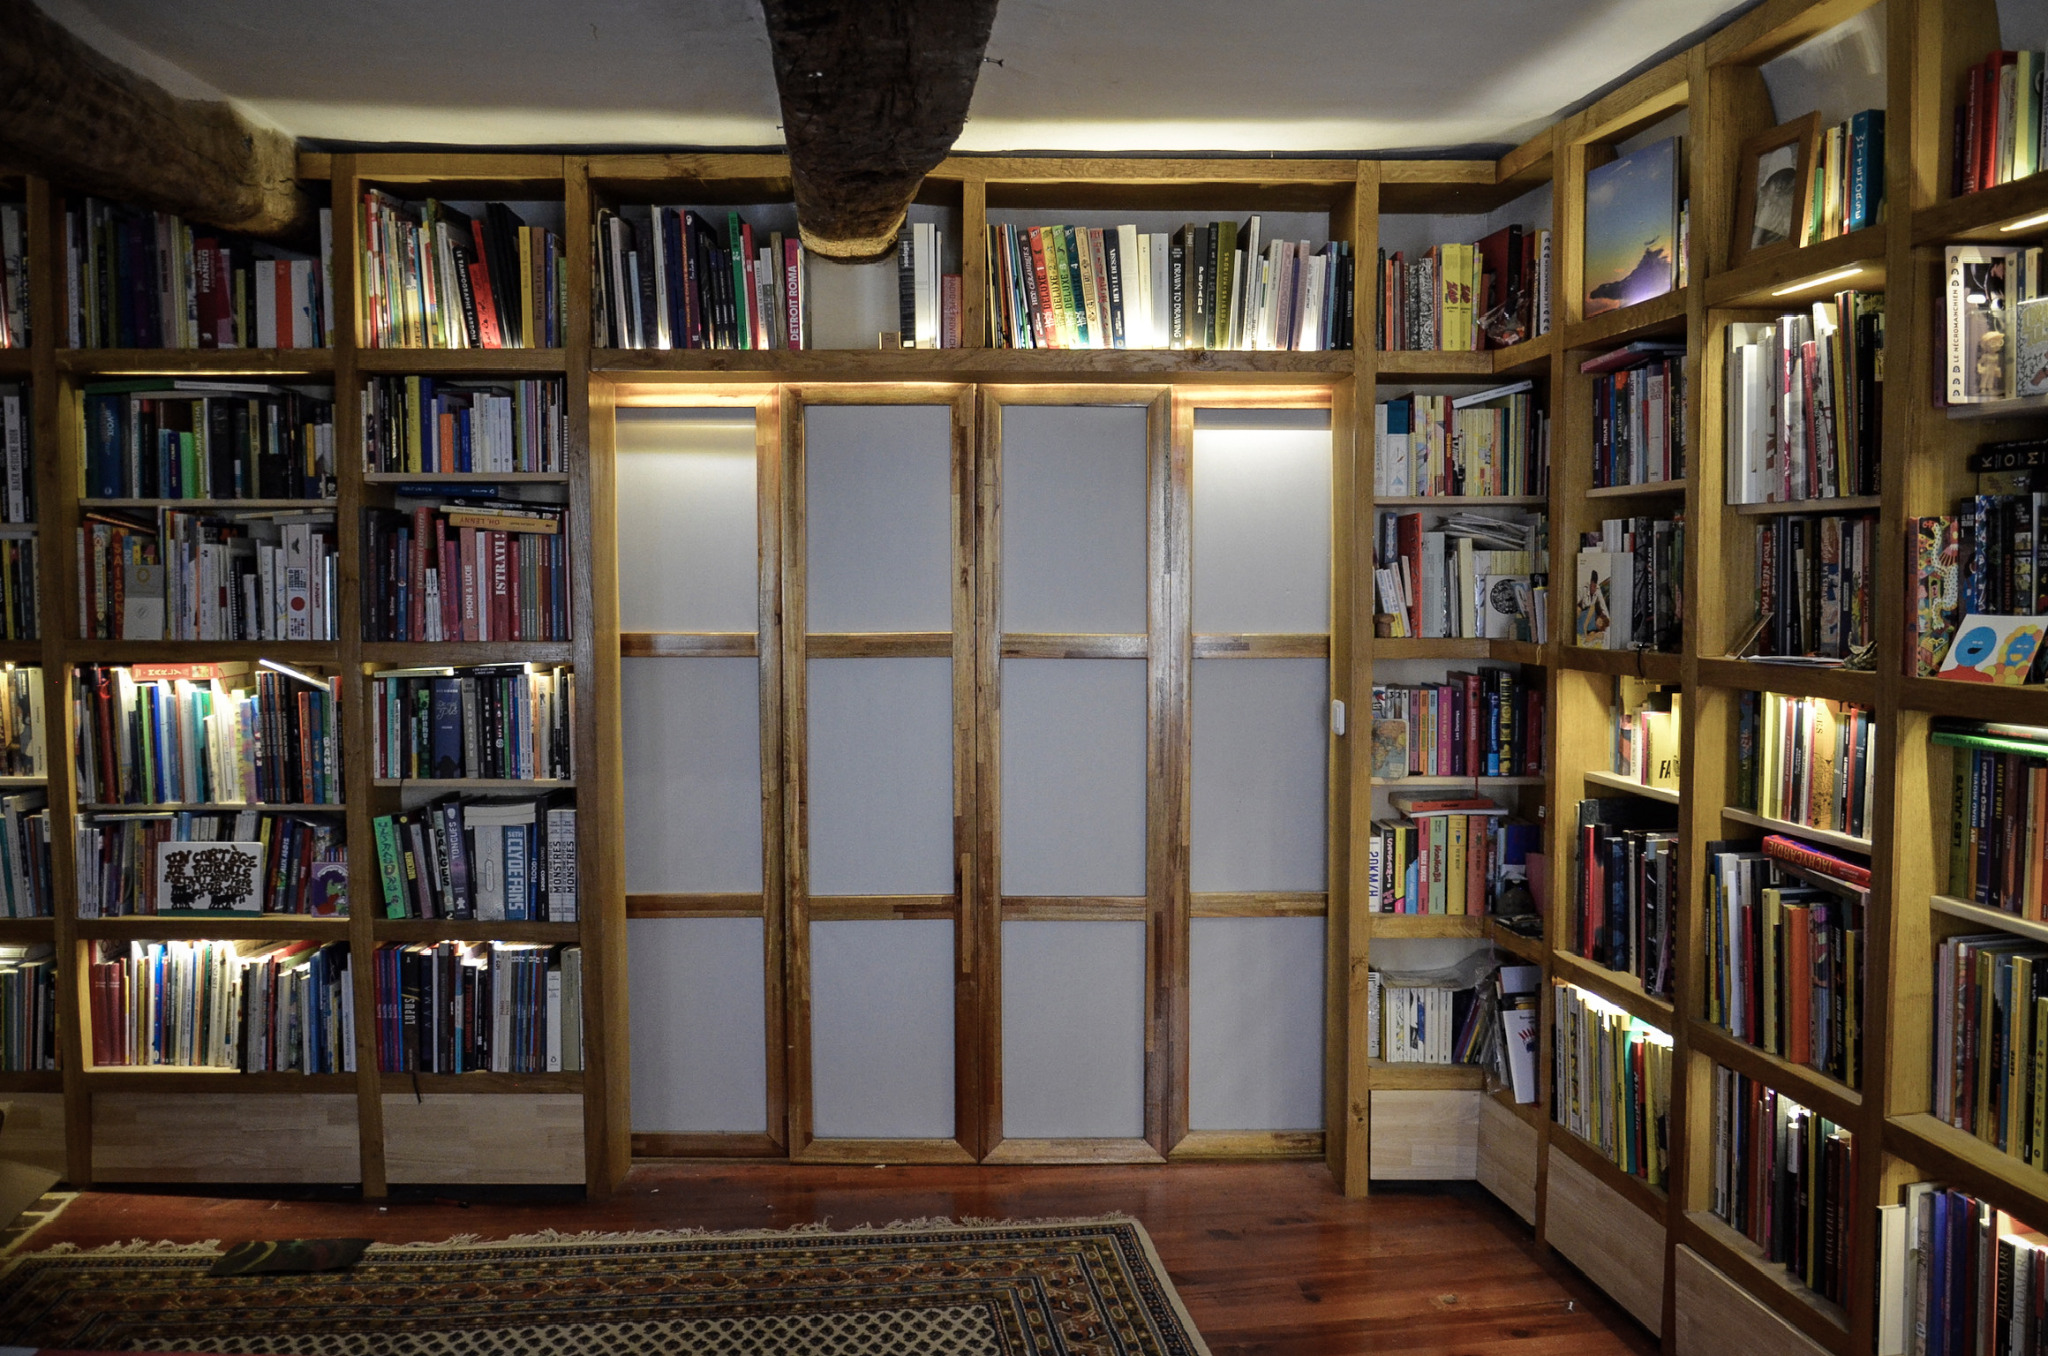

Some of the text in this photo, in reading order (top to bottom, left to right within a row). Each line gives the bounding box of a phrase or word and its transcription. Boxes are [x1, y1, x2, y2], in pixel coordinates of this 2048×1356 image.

[1854, 134, 1866, 220] WHITEHORSE
[201, 249, 210, 294] FRANCO
[455, 250, 463, 258] LE
[457, 259, 472, 309] TAMPOGRAPHE
[1038, 275, 1052, 309] DELUXE
[1050, 275, 1062, 310] DELUXE
[1060, 273, 1072, 309] DELUXE
[1173, 262, 1182, 290] DRAWN
[1196, 266, 1204, 314] POSADA
[787, 265, 799, 341] DETROIT ROMA
[1173, 292, 1182, 302] TO
[466, 311, 477, 340] SARDON
[1173, 303, 1182, 338] DRAWING
[1952, 352, 1959, 364] LE
[464, 565, 473, 586] LUCIE
[494, 542, 506, 596] ISTRATI
[465, 595, 474, 620] SIMON
[147, 668, 182, 676] MARLY
[323, 736, 331, 774] BANG
[1953, 775, 1963, 849] LES JULYS
[436, 828, 450, 887] GANGES
[448, 821, 459, 860] TONGUES
[1766, 842, 1833, 875] TACHYCARDIE
[508, 838, 524, 910] CLYDE FANS
[553, 841, 562, 894] MONSTRES
[566, 841, 575, 894] MONSTRES
[404, 998, 416, 1025] LUPUS
[423, 984, 432, 1028] AAMA
[2015, 1259, 2028, 1326] PALOMAR
